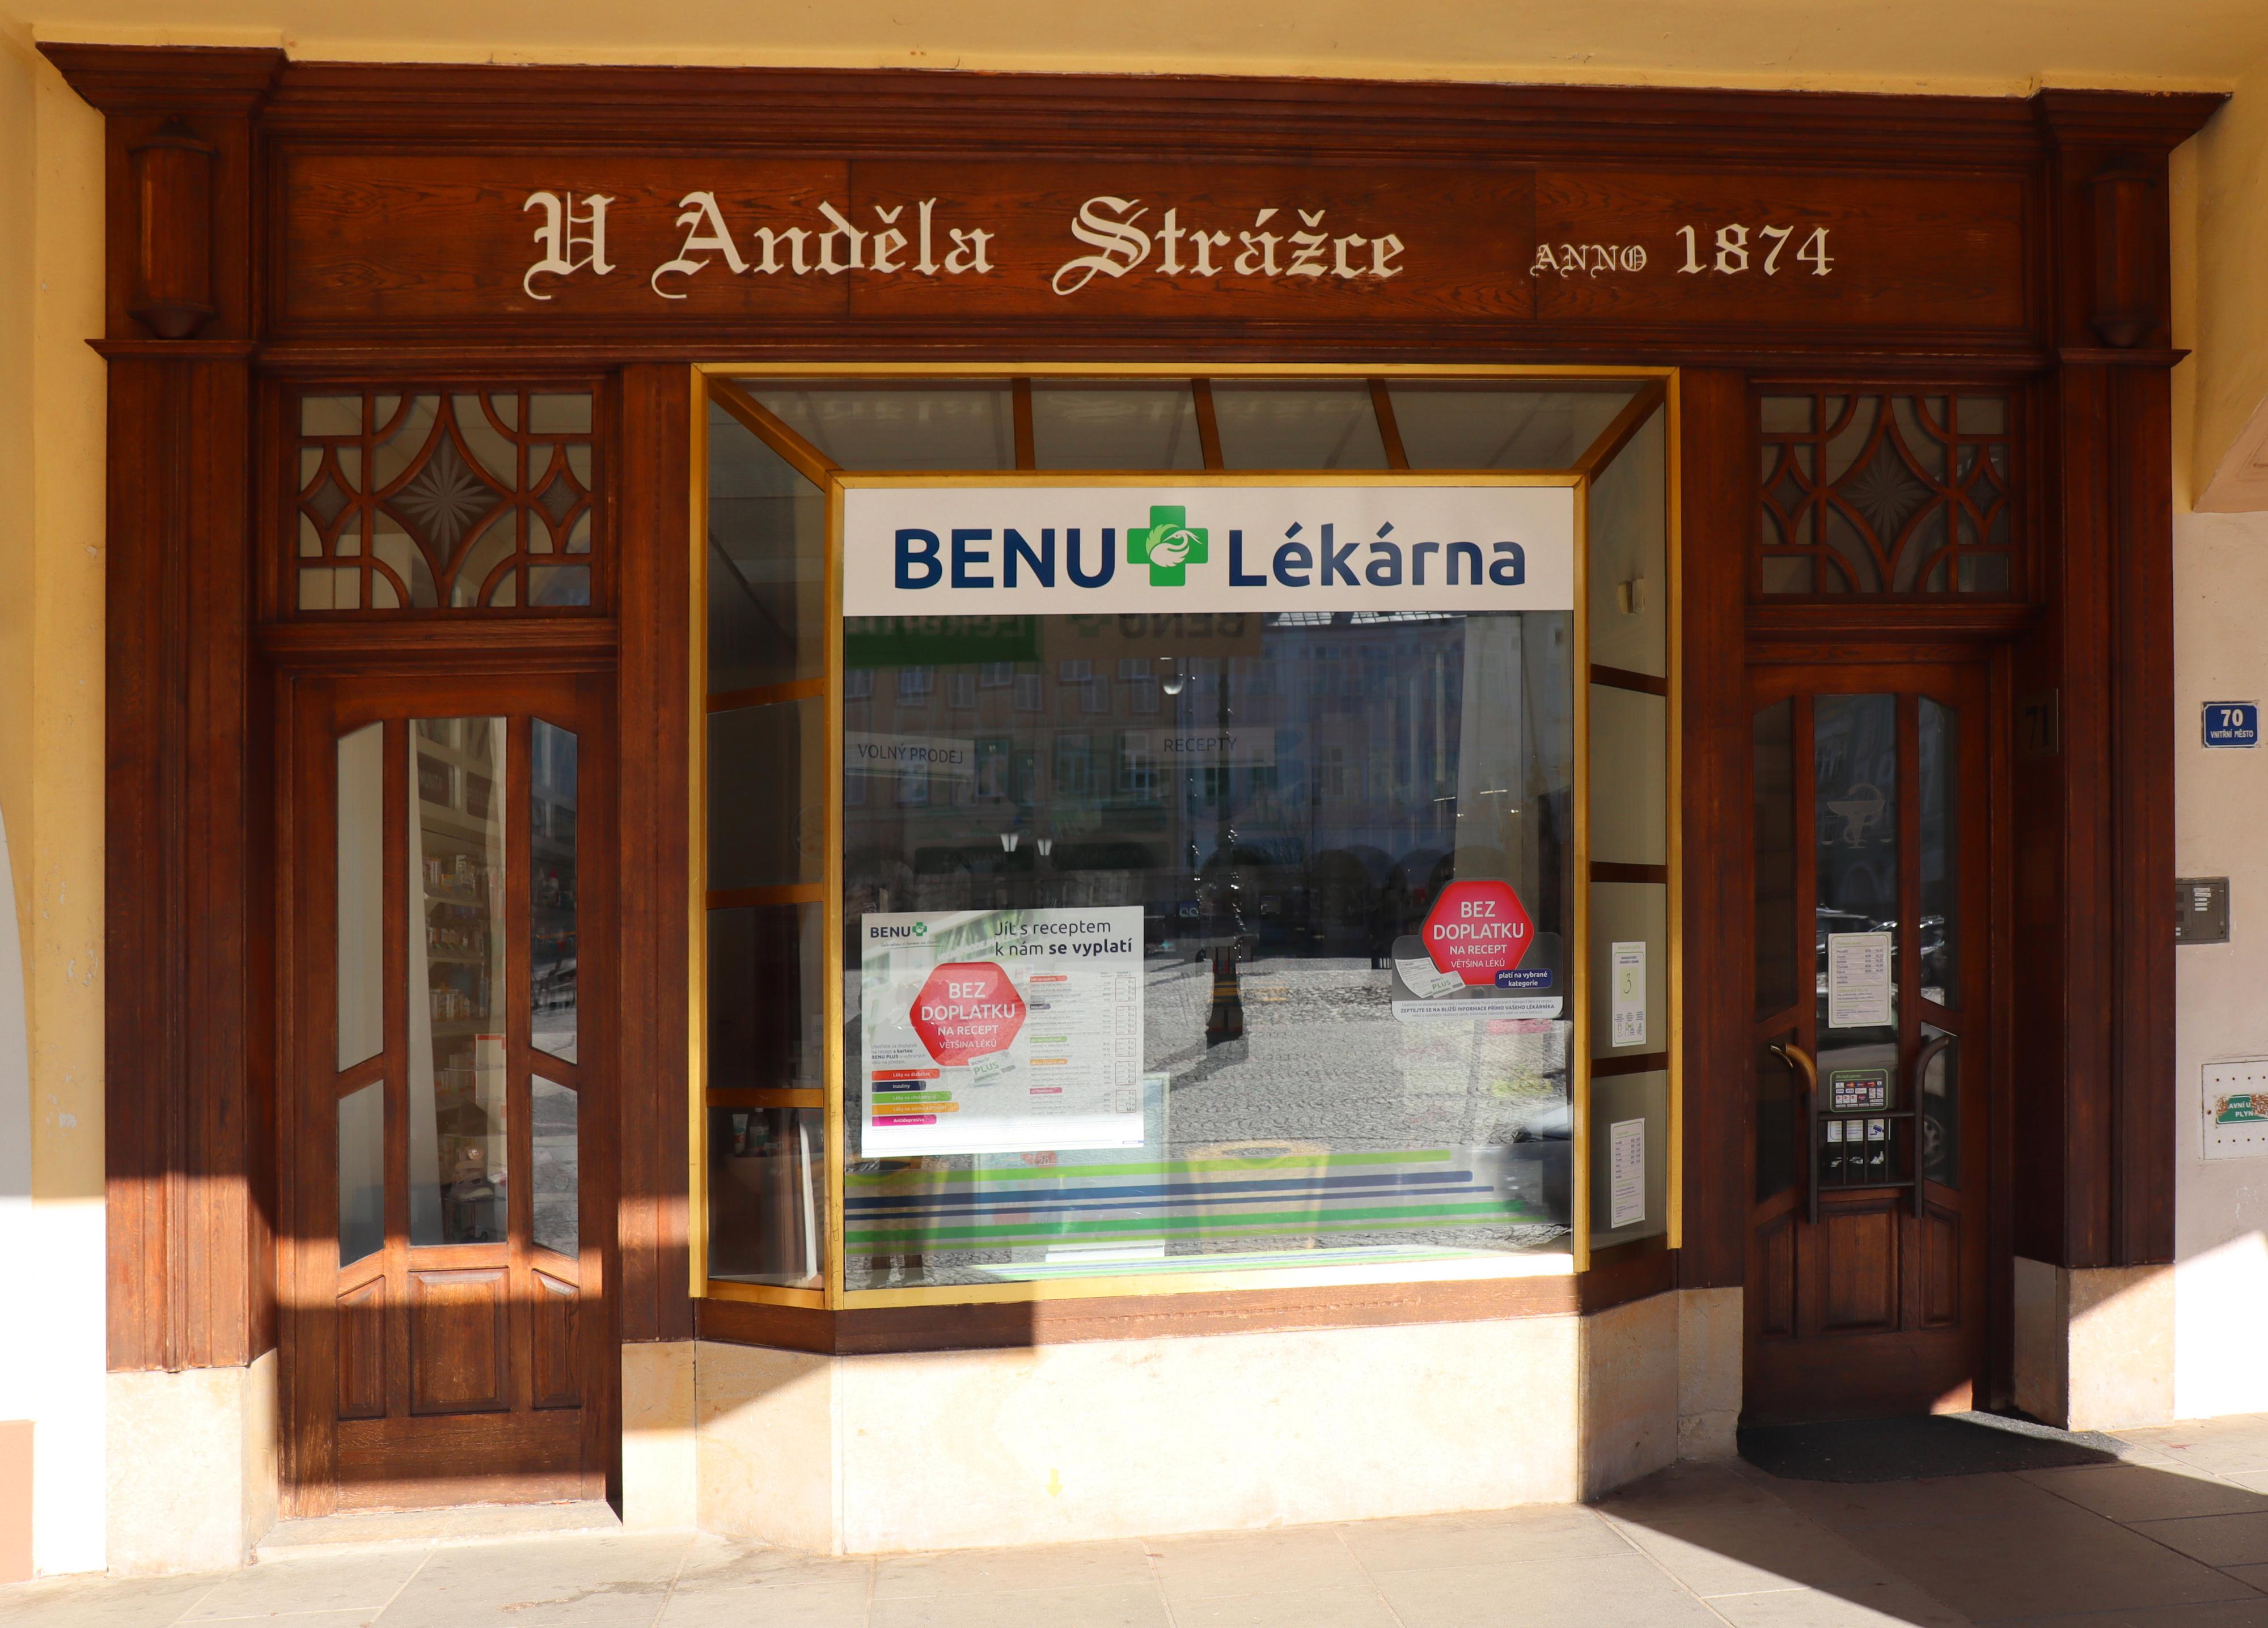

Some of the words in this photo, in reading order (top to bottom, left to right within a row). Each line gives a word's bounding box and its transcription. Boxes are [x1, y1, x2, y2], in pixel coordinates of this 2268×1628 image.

[651, 191, 995, 299] Anděla
[1052, 196, 1405, 295] Strážce
[1530, 243, 1647, 278] ANNO
[1676, 223, 1834, 276] 1874
[894, 528, 1115, 590] BENU
[1229, 521, 1526, 587] Lékárna
[2220, 709, 2244, 727] 70
[2210, 729, 2232, 739] VNITŘNÍ
[2235, 728, 2254, 737] MĚSTO
[1164, 737, 1237, 752] RECEPTY
[858, 743, 906, 760] VOLNÝ
[910, 747, 963, 764] PRODEJ
[1461, 901, 1496, 918] BEZ
[870, 926, 911, 938] BENU
[995, 921, 1015, 935] Jít
[1021, 924, 1027, 935] s
[1033, 921, 1111, 936] receptem
[1433, 922, 1524, 940] DOPLATKU
[996, 942, 1004, 956] k
[1010, 942, 1043, 956] nám
[1049, 943, 1067, 955] se
[1072, 938, 1132, 957] vyplatí
[1450, 946, 1465, 955] NA
[1468, 944, 1507, 955] RECEPT
[1451, 959, 1484, 968] VĚTŠINA
[1486, 957, 1505, 967] LÉKŮ
[1523, 970, 1548, 979] vybrané
[949, 982, 986, 999] BEZ
[1432, 980, 1451, 990] PLUS
[1623, 973, 1632, 994] 3
[921, 1003, 1016, 1021] DOPLATKU
[938, 1027, 954, 1036] NA
[957, 1025, 998, 1035] RECEPT
[940, 1039, 974, 1049] VĚTŠINA
[976, 1038, 997, 1048] LÉKŮ
[974, 1062, 999, 1075] PLUS
